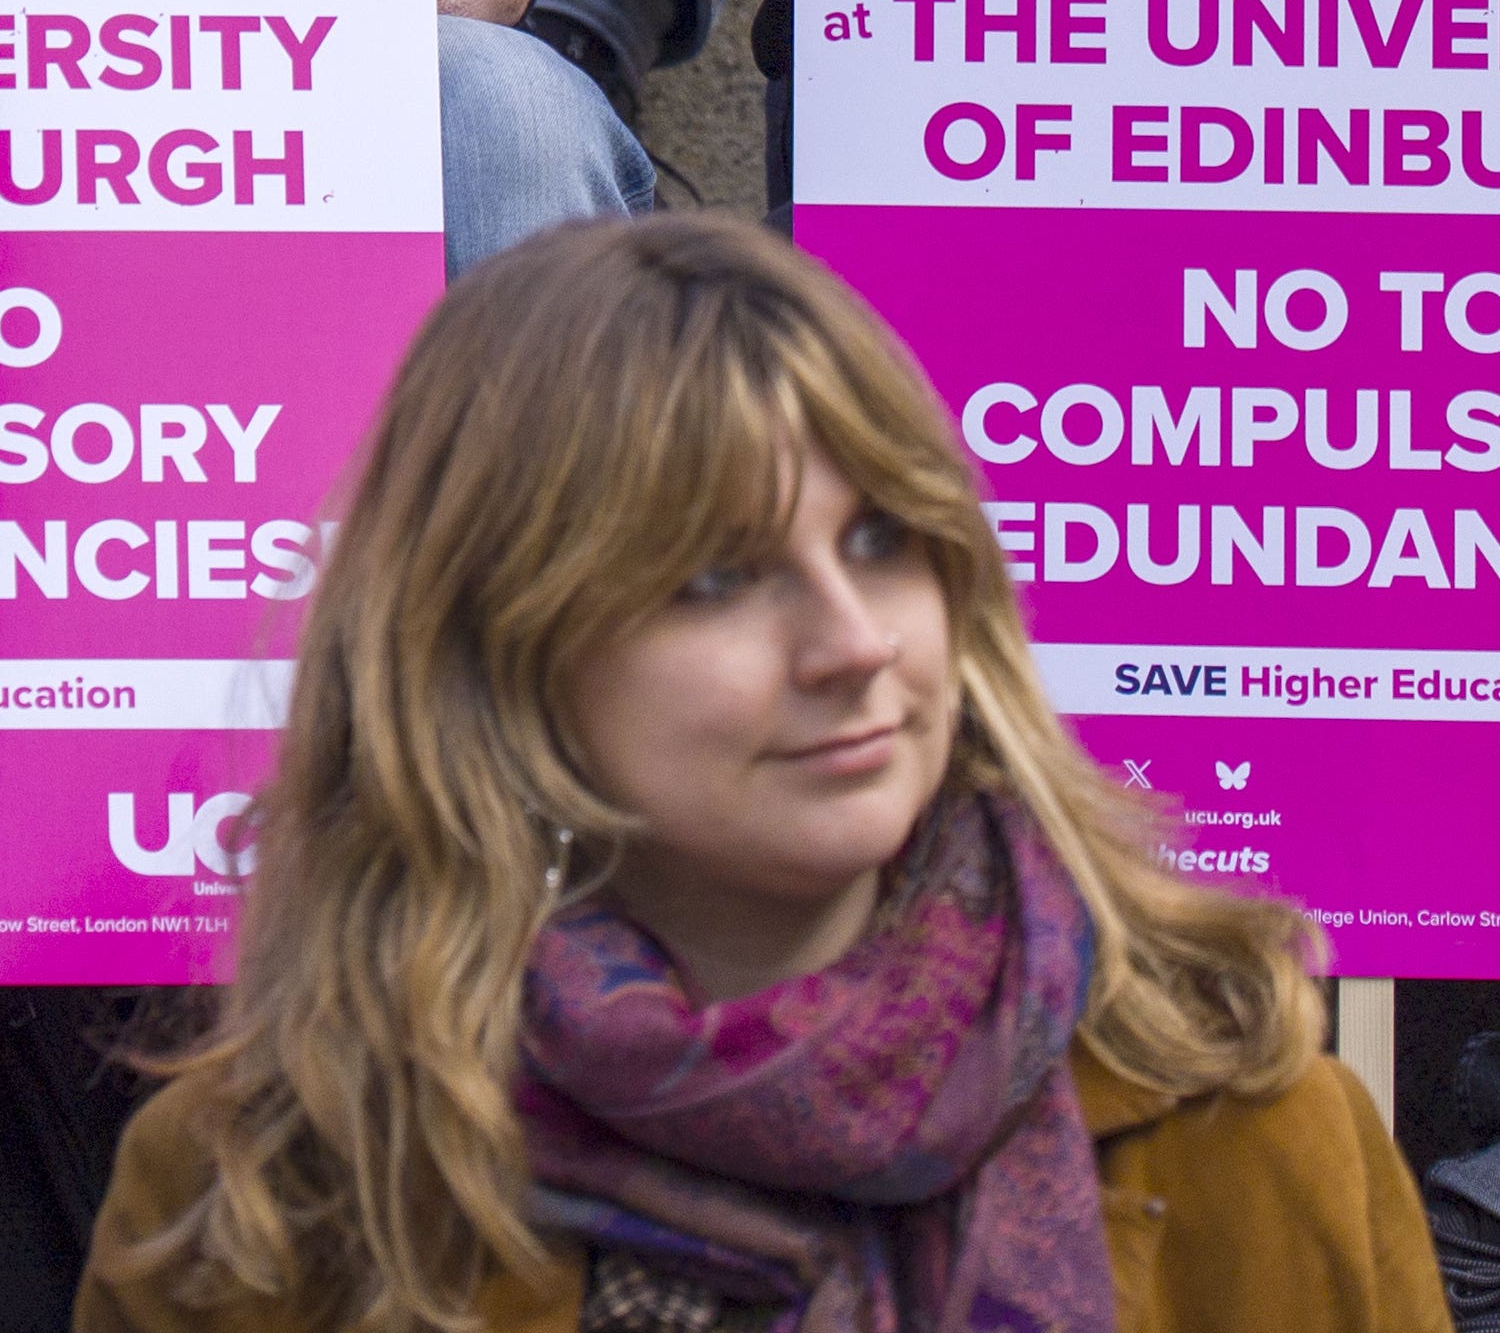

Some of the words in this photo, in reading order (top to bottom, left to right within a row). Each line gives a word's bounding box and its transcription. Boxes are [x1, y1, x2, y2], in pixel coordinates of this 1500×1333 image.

[822, 3, 872, 44] at
[924, 101, 1073, 181] OF
[1183, 269, 1347, 351] NO
[1115, 664, 1226, 698] SAVE
[1241, 665, 1378, 707] Higher
[108, 791, 257, 877] UC
[1186, 810, 1281, 828] ucu.org.uk
[27, 916, 80, 934] Street,
[85, 916, 147, 933] London
[152, 917, 190, 933] NW1
[195, 918, 228, 933] 7LH
[1304, 909, 1354, 927] ollege
[1359, 908, 1412, 927] Union,
[1417, 908, 1476, 927] Carlow
